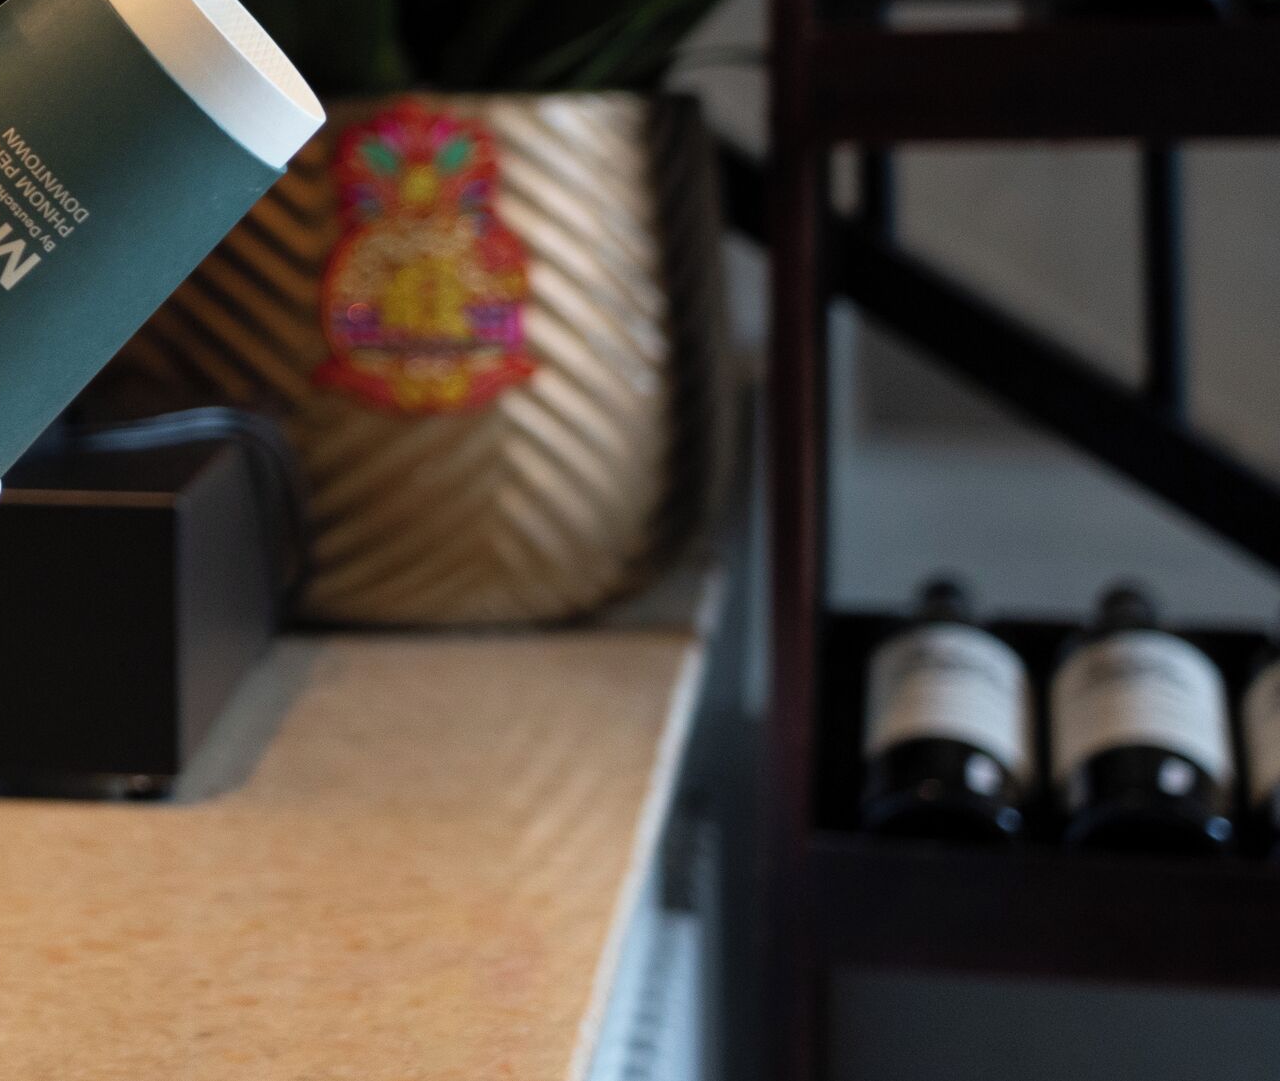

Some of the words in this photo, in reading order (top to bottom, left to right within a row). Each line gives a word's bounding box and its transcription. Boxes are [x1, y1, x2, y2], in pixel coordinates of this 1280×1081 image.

[2, 127, 90, 224] DOWNTOWN
[14, 176, 75, 238] PHNOM
[39, 234, 56, 253] By
